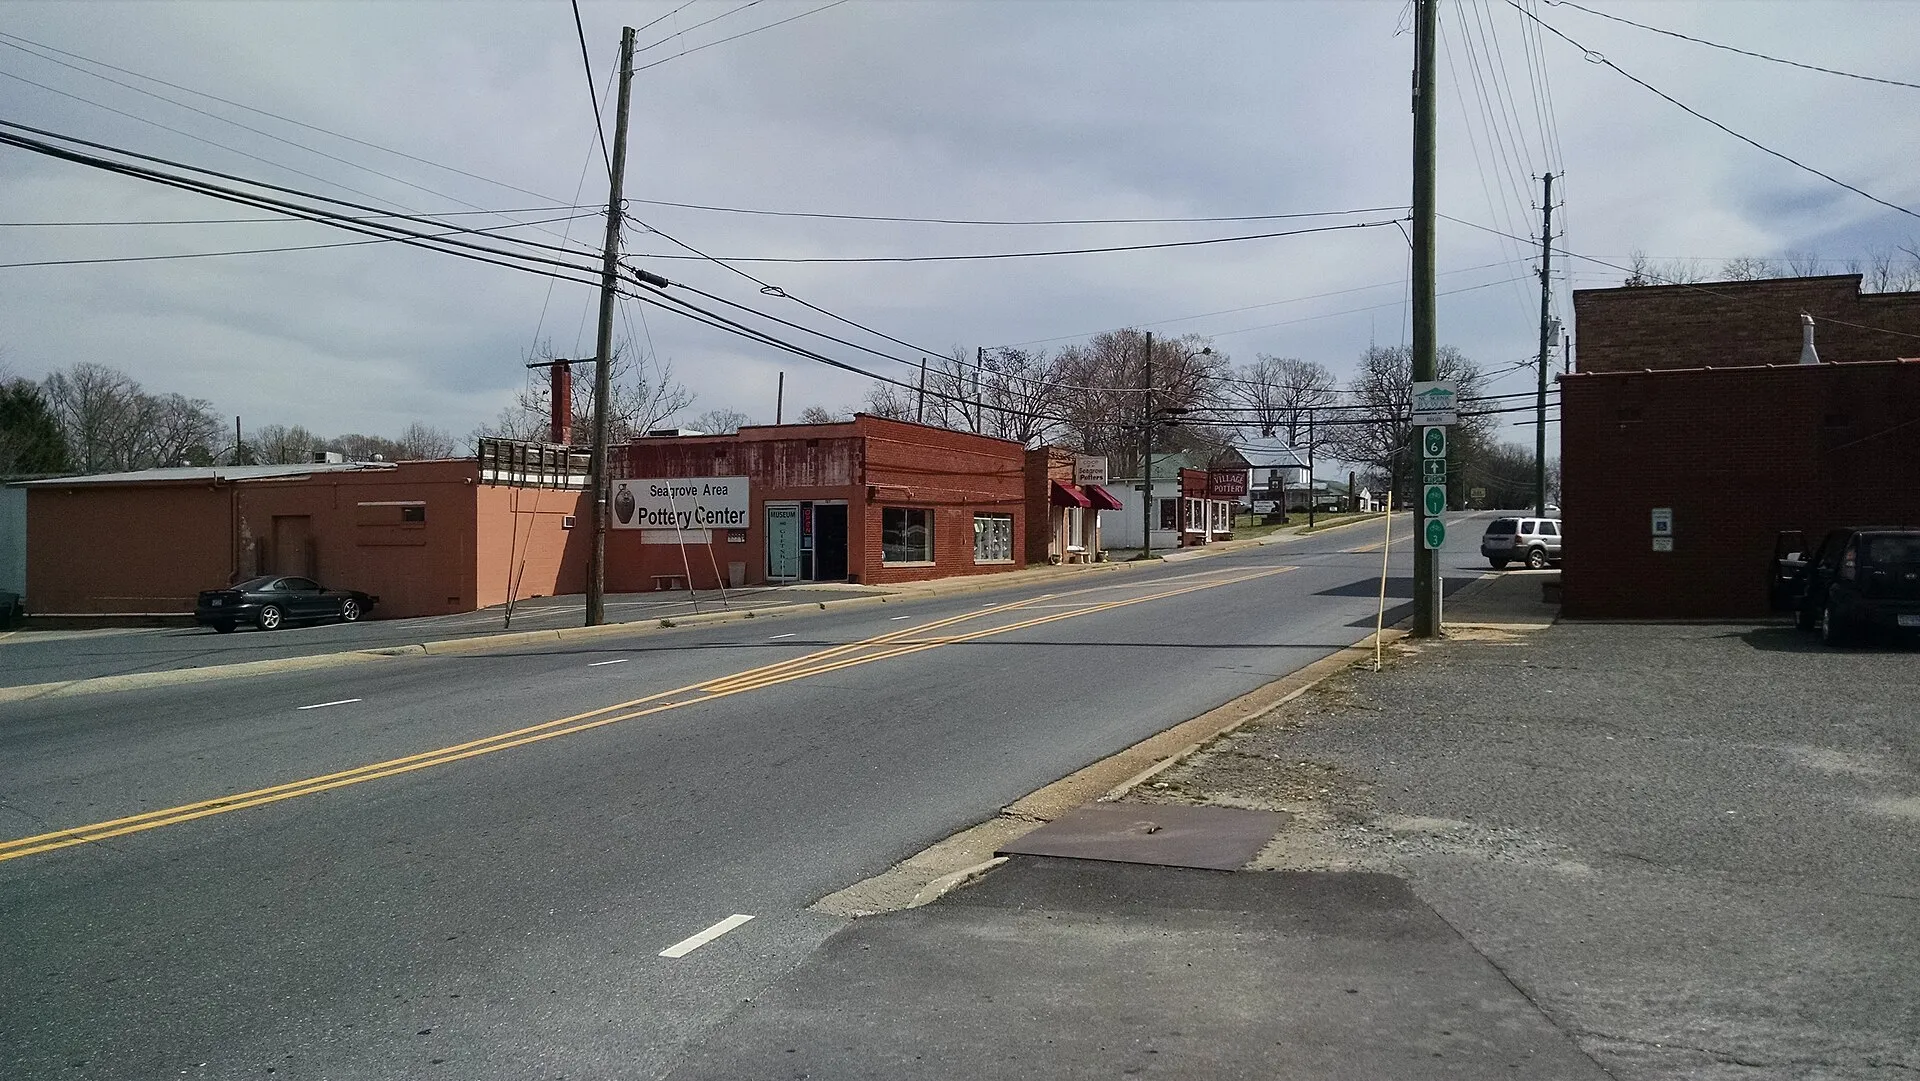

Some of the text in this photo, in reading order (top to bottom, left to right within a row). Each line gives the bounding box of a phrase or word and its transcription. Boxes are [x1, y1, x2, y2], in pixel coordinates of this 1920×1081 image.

[1430, 442, 1438, 452] 6
[1213, 474, 1244, 485] VILLAGE
[650, 483, 728, 499] Seagrove Area
[1214, 485, 1244, 493] POTTERY
[1433, 502, 1437, 512] 1
[638, 505, 746, 529] Pottery Center
[1432, 535, 1438, 545] 3
